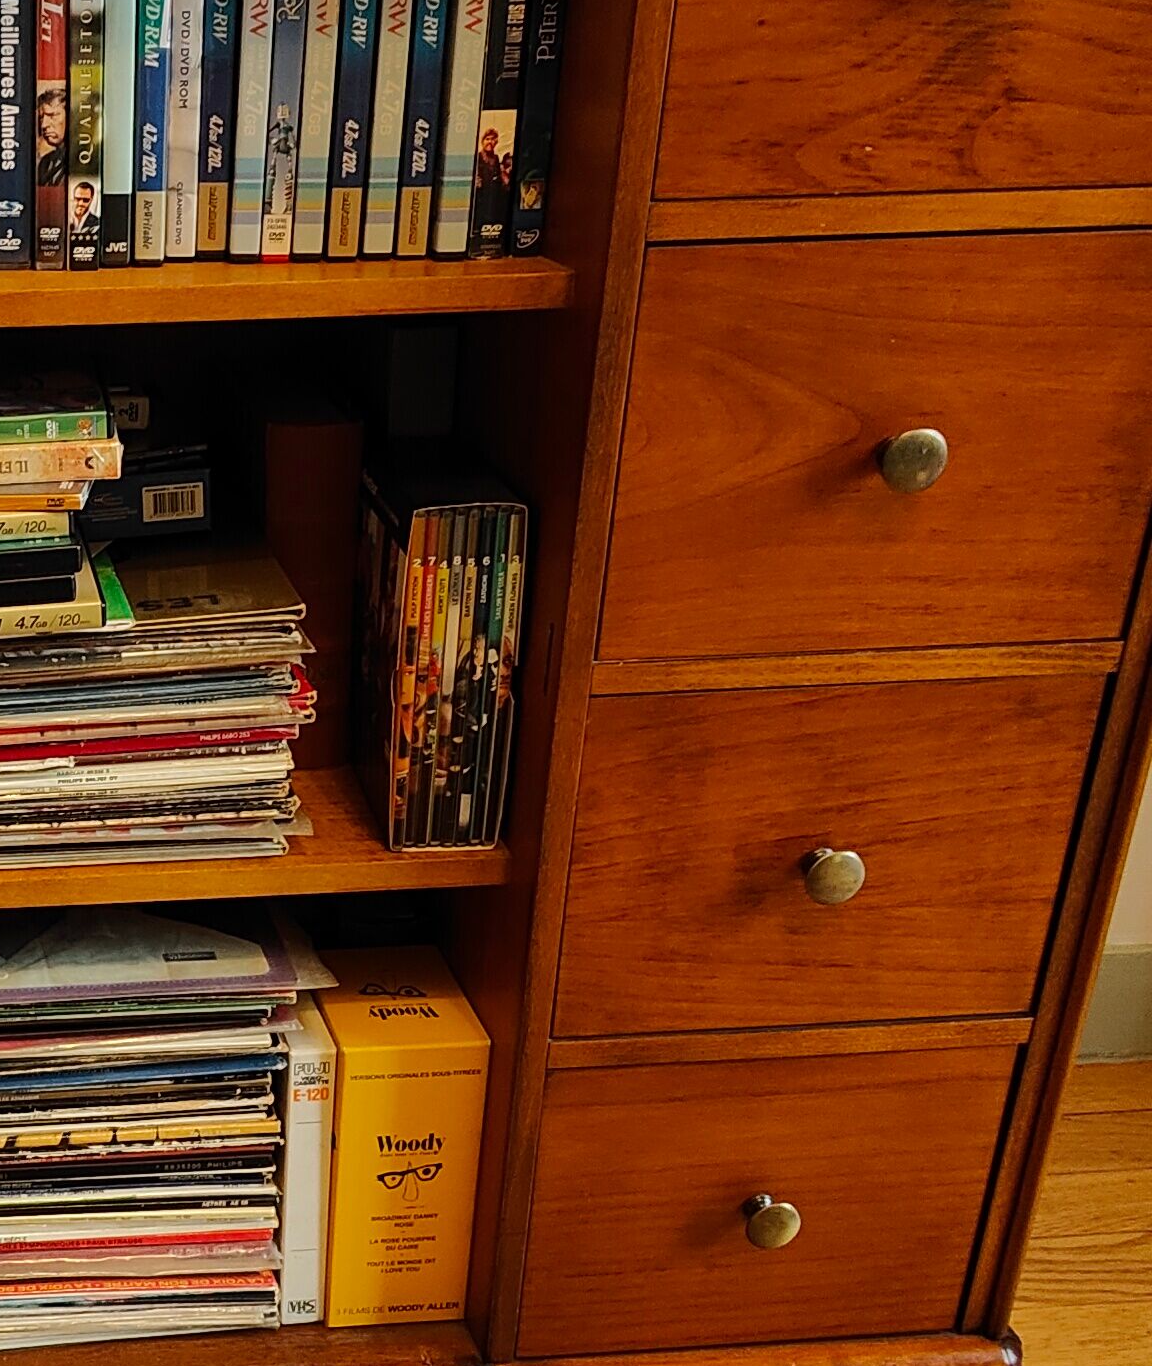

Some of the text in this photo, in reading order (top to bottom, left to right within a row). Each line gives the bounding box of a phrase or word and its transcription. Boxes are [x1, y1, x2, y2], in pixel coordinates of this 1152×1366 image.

[40, 12, 53, 44] LE
[535, 2, 561, 65] PETER
[178, 79, 189, 109] ROM
[78, 67, 95, 165] QUATRE
[0, 103, 21, 171] Années
[175, 181, 184, 224] CLEANING
[40, 227, 61, 235] DVD
[72, 246, 96, 256] DVD
[105, 241, 128, 253] JVC
[16, 459, 29, 468] IL
[412, 558, 422, 568] 2
[427, 556, 437, 566] 7
[453, 556, 462, 566] 8
[467, 557, 476, 567] 5
[482, 556, 491, 566] 6
[500, 553, 506, 563] 1
[511, 555, 520, 564] 3
[439, 560, 448, 569] 4
[14, 615, 48, 630] 4.7GB
[369, 1004, 440, 1021] Woody
[293, 1061, 331, 1076] FUJI
[350, 1073, 386, 1081] VERSIONS
[386, 1071, 430, 1080] ORIGINALES
[293, 1087, 330, 1102] E-120
[376, 1132, 447, 1153] Woody
[159, 1280, 189, 1288] SON
[192, 1278, 212, 1286] DE
[213, 1277, 246, 1285] VOIX
[17, 1284, 37, 1292] DE
[39, 1283, 74, 1291] VOIX
[288, 1300, 317, 1314] VHS
[343, 1301, 460, 1315] FILMS DE WOODY ALLEN
